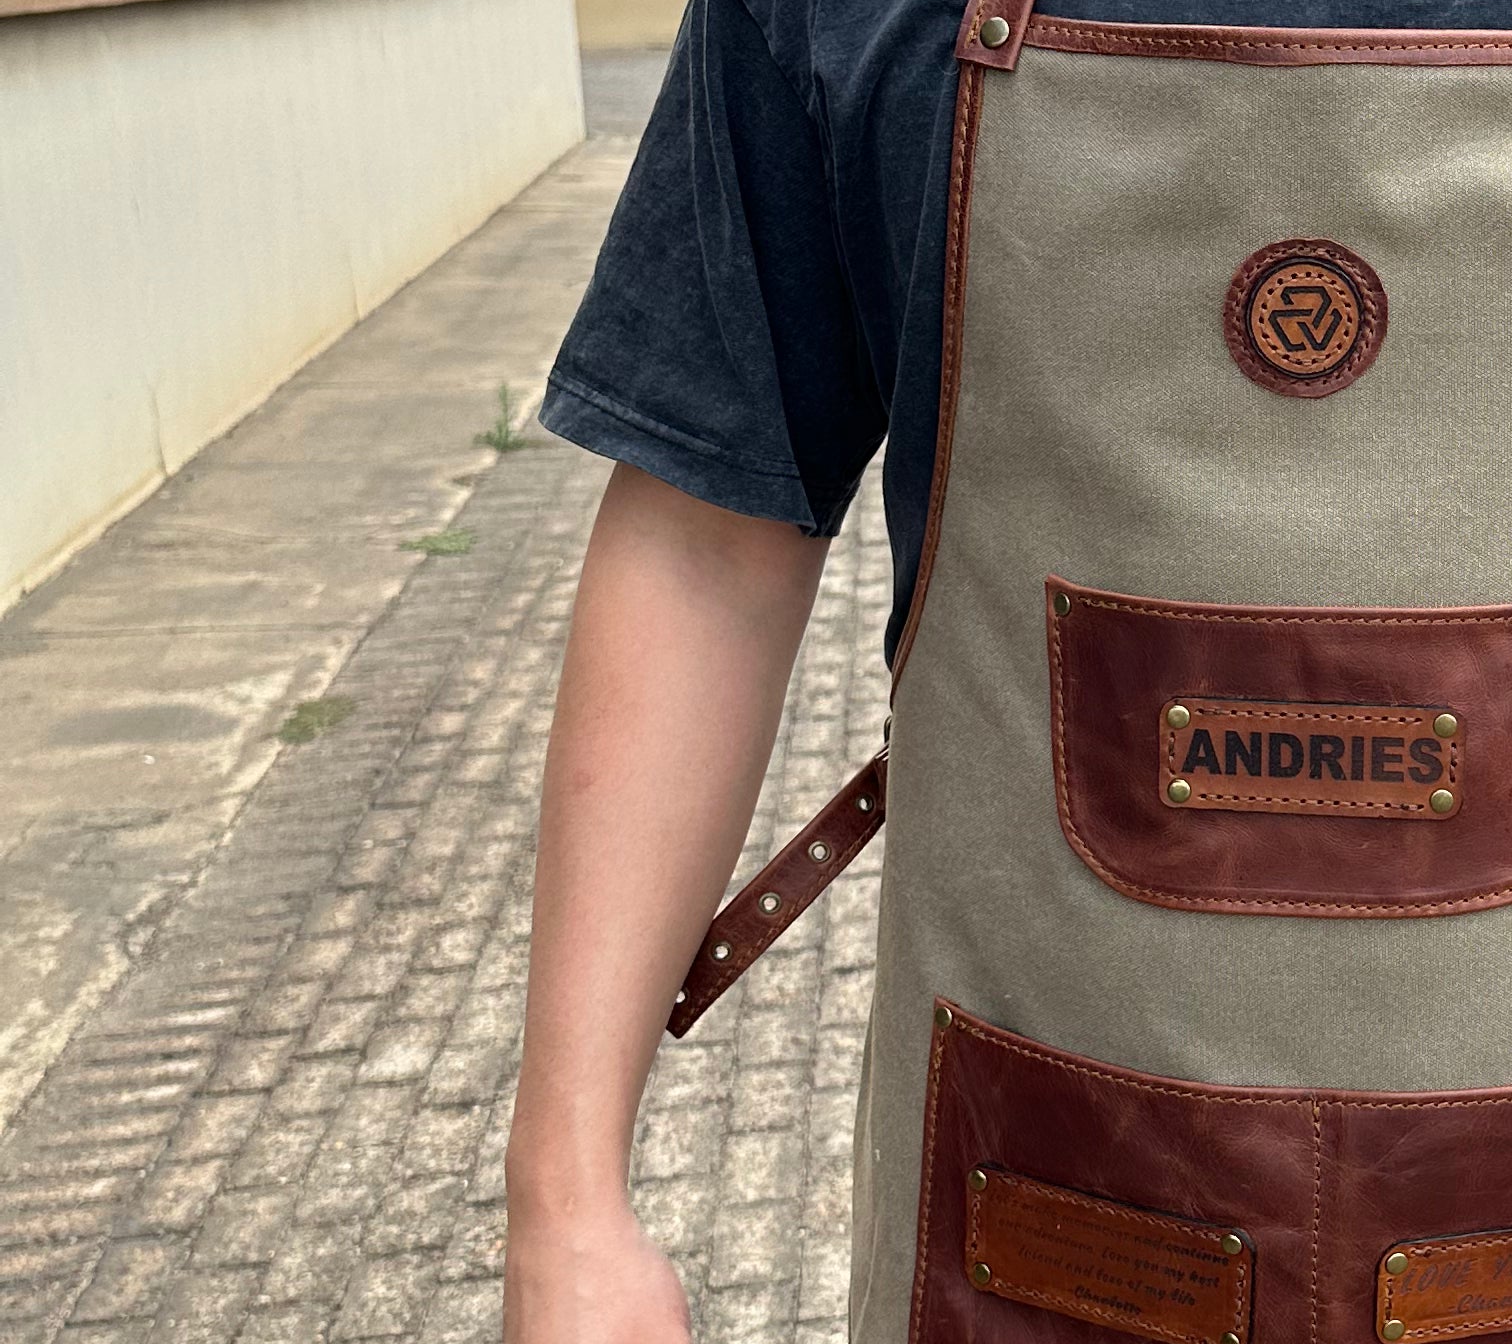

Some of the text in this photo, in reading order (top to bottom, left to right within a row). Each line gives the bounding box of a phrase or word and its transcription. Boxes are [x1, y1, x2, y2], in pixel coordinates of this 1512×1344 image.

[1181, 728, 1445, 785] ANDRIES
[1167, 1242, 1229, 1266] continue
[1018, 1244, 1196, 1307] friend and love of my life
[1134, 1258, 1159, 1273] you
[1164, 1265, 1185, 1282] my
[1190, 1270, 1221, 1288] best
[1399, 1258, 1479, 1295] LOVE
